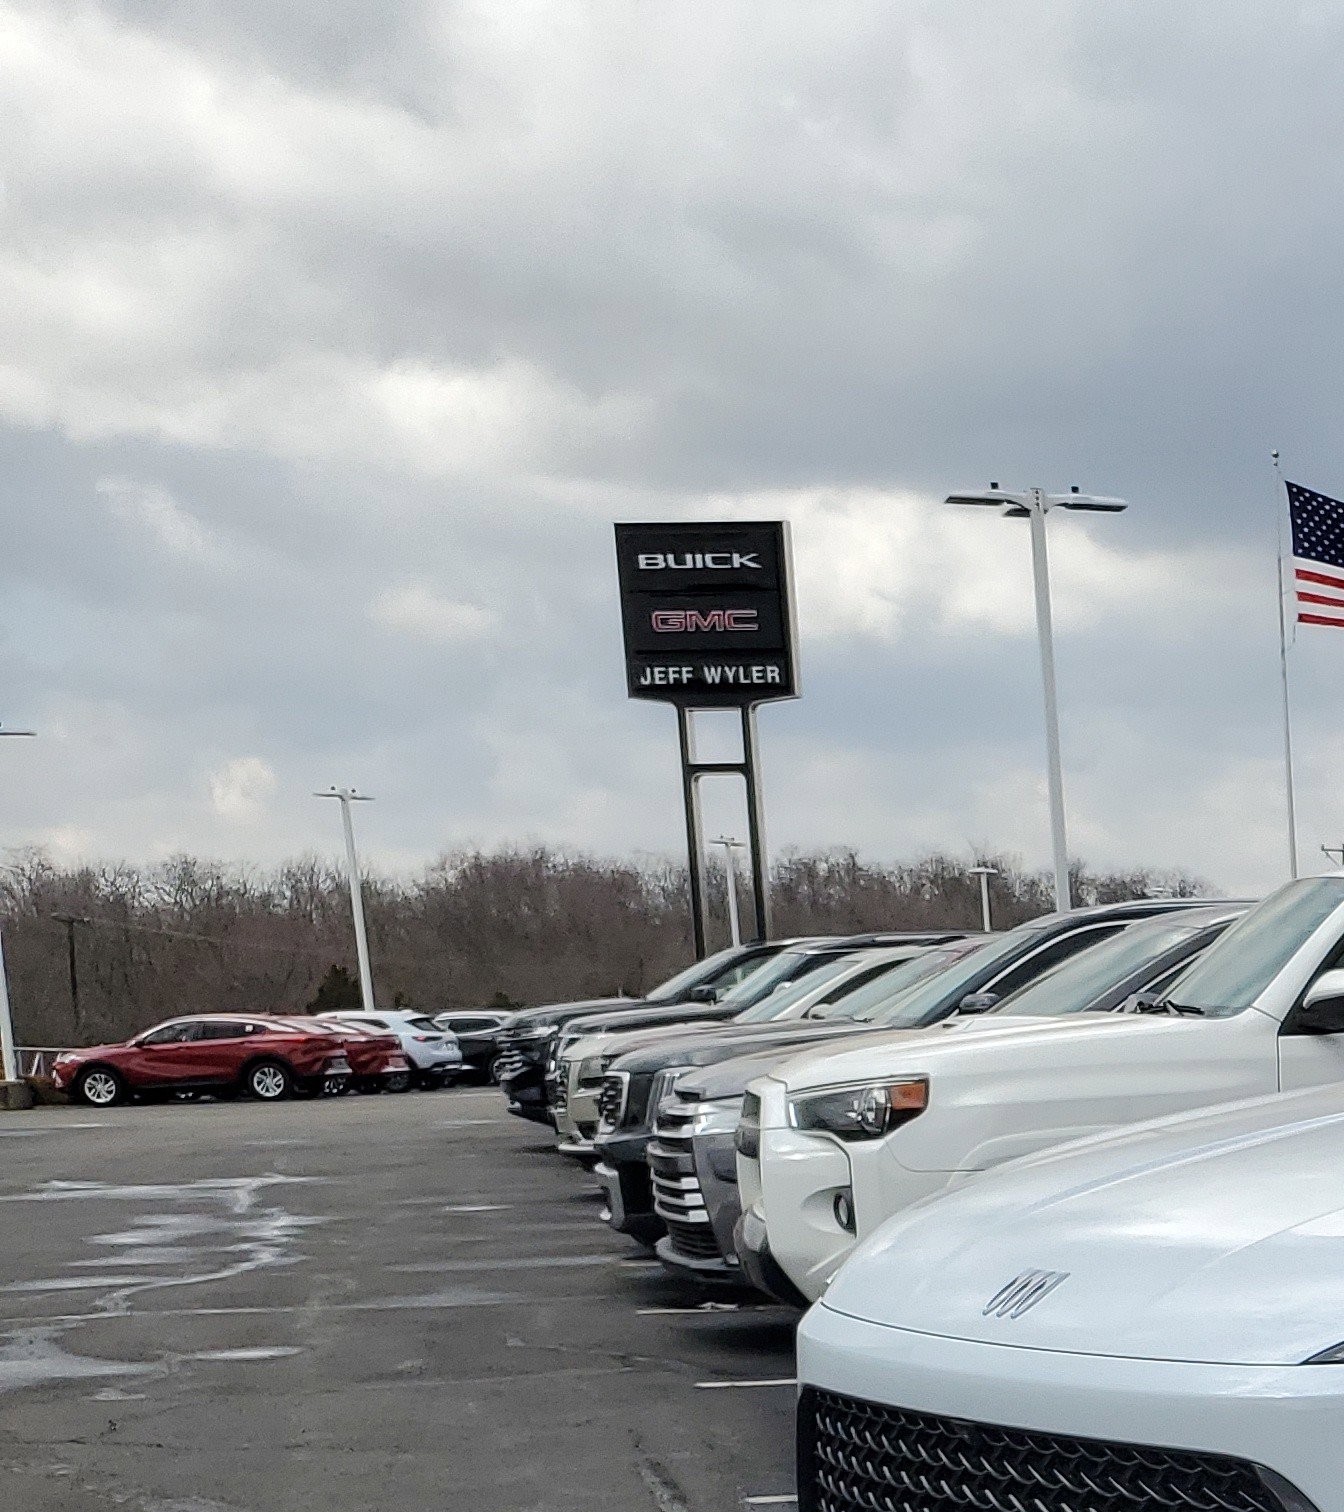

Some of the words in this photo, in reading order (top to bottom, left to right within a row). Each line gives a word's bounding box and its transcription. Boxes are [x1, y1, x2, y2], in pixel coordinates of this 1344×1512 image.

[637, 552, 763, 570] BUICK
[651, 610, 760, 633] GMC
[640, 665, 694, 686] JEFF
[703, 665, 781, 685] WYLER
